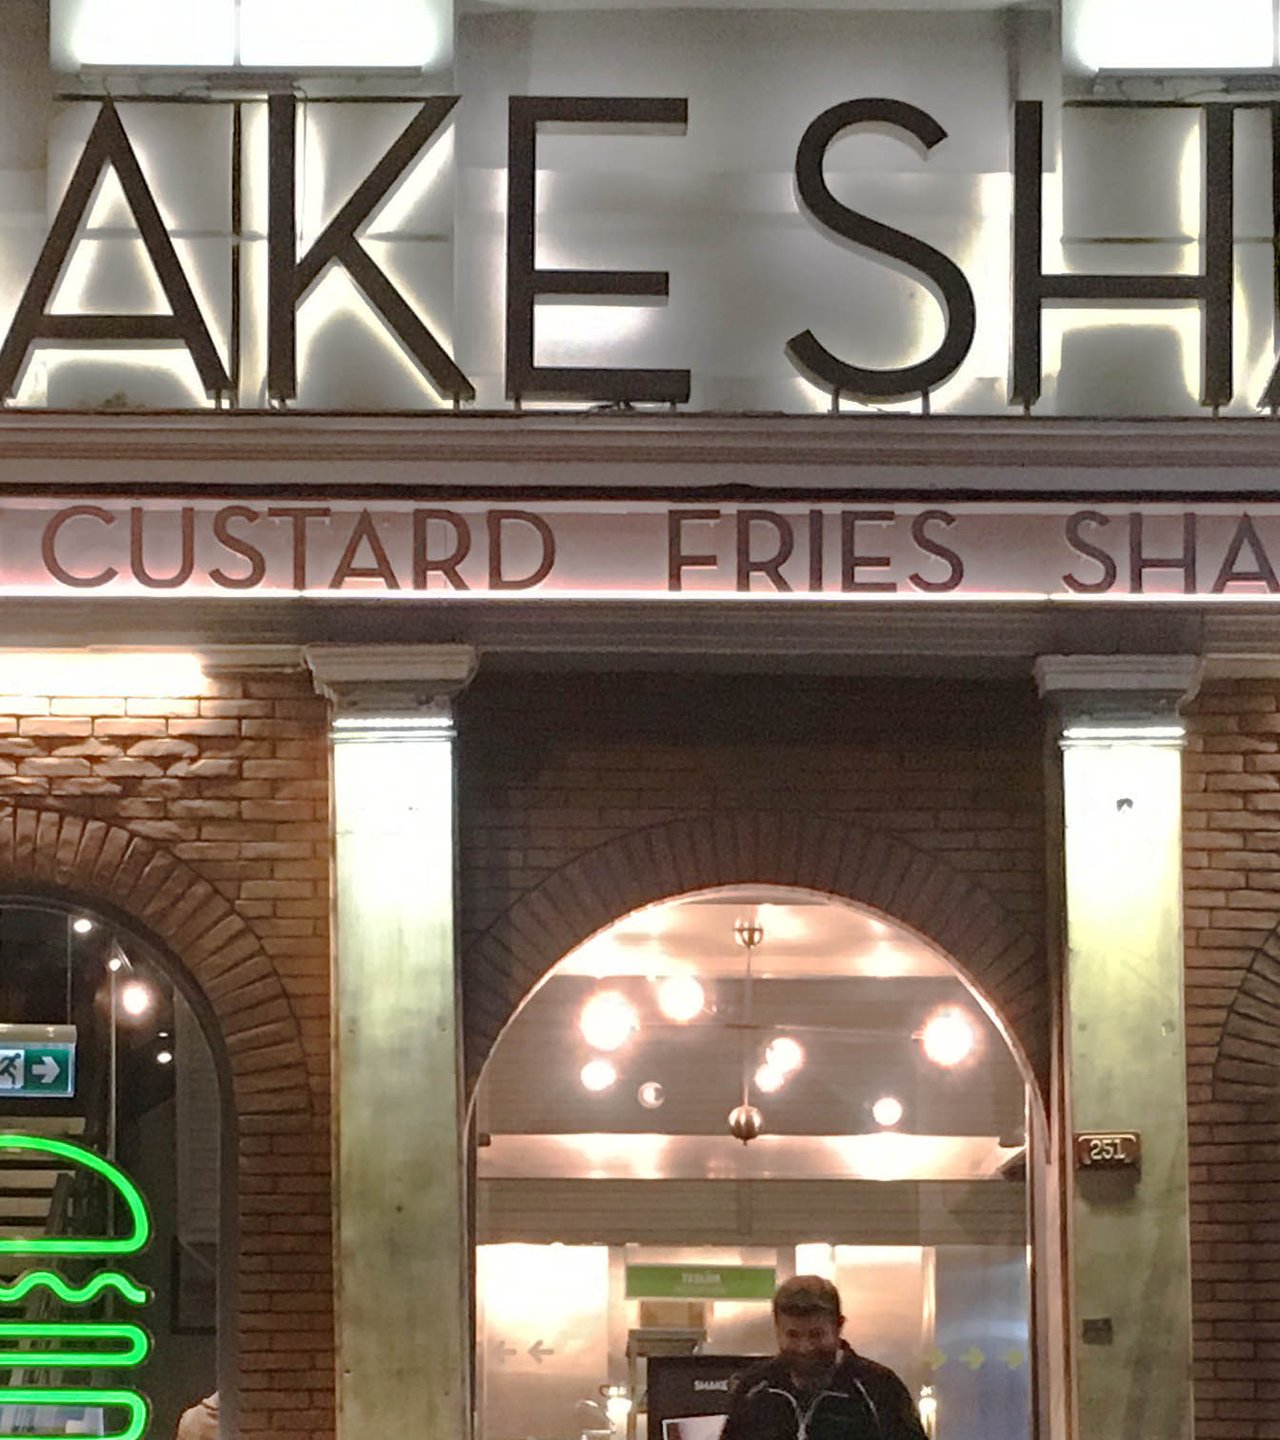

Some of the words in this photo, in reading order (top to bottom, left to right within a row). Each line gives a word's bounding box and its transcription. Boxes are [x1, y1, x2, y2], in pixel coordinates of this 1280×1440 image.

[41, 503, 558, 592] CUSTARD
[667, 508, 965, 594] FRIES
[1089, 1138, 1127, 1160] 251
